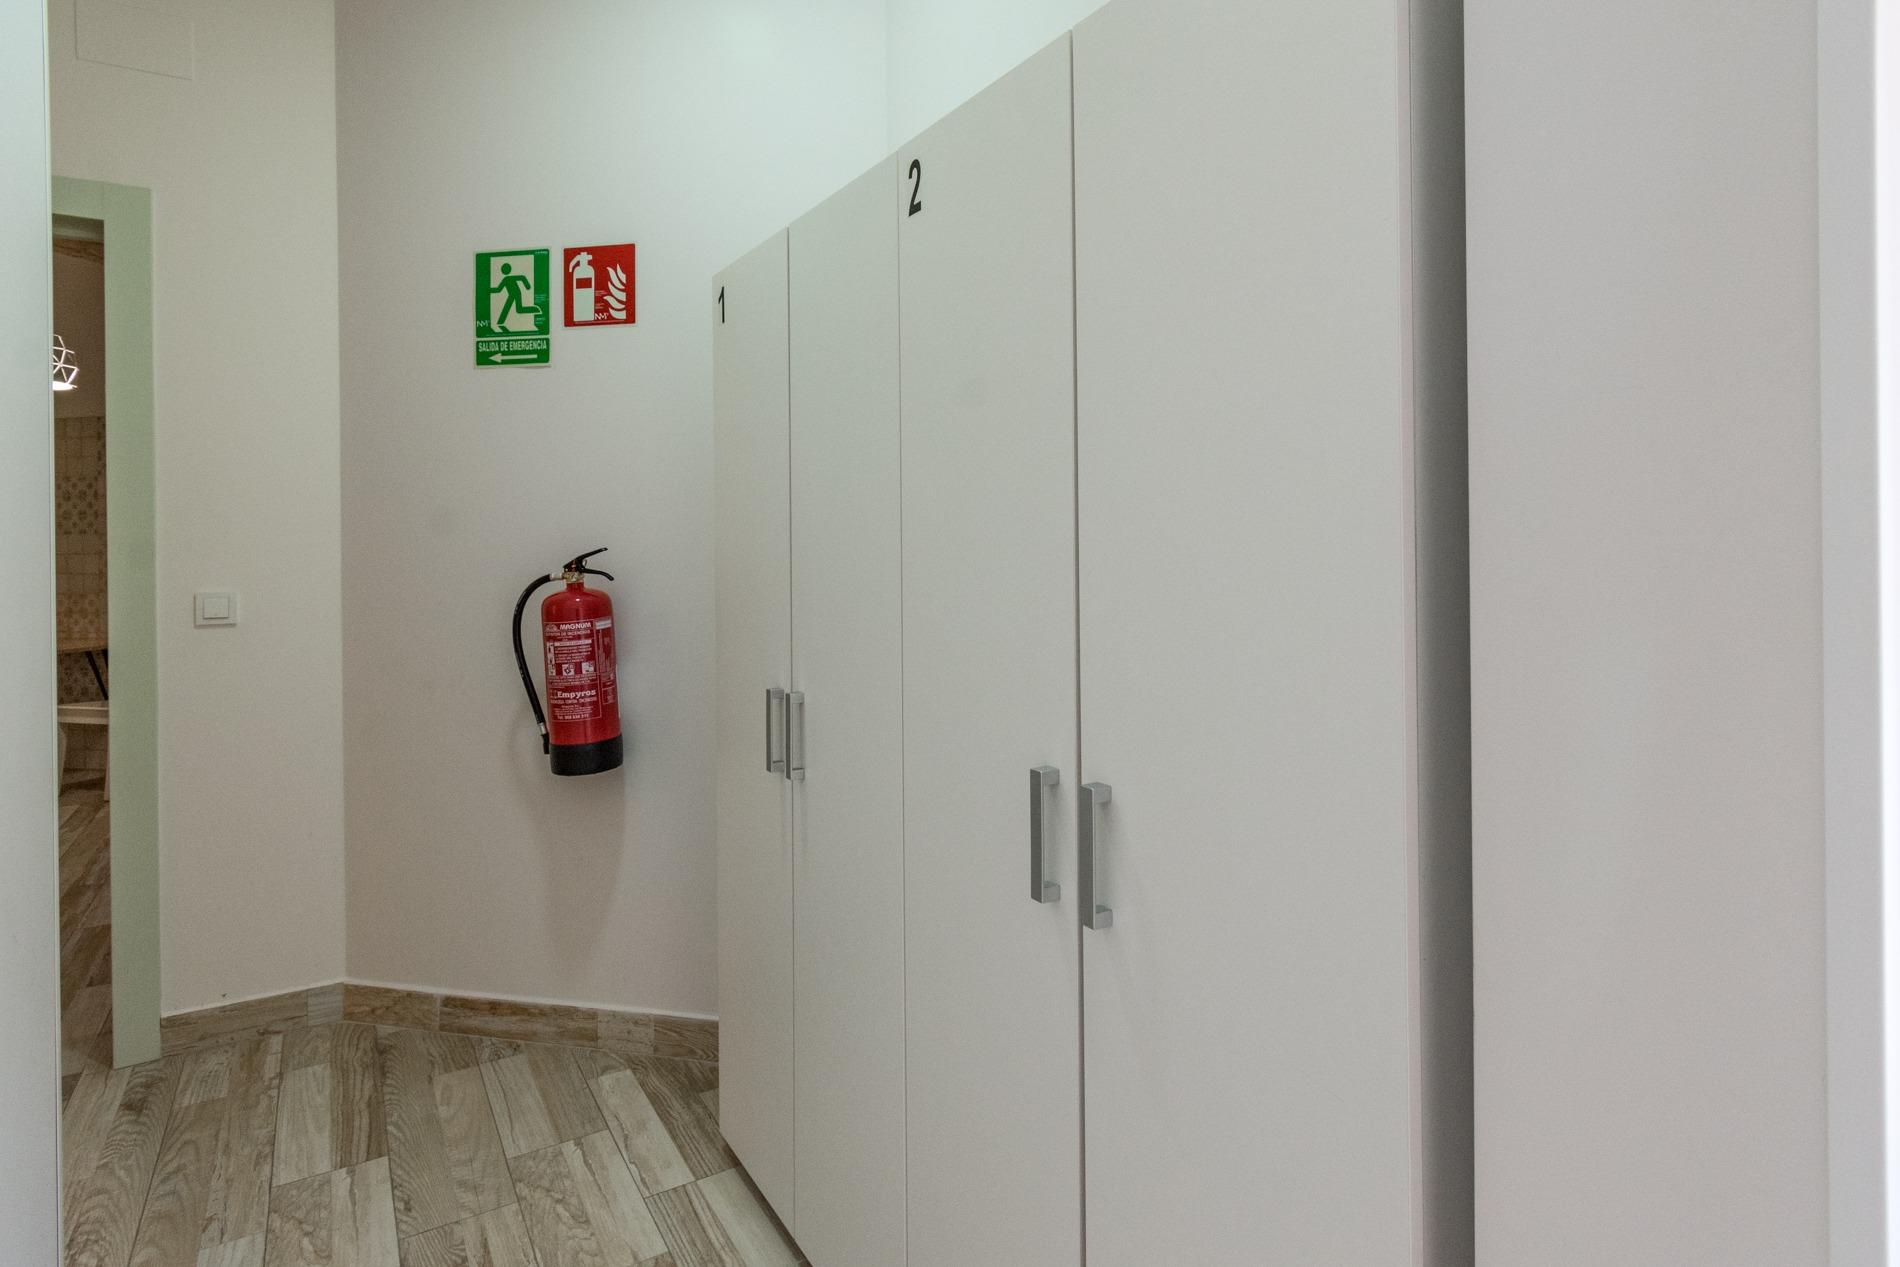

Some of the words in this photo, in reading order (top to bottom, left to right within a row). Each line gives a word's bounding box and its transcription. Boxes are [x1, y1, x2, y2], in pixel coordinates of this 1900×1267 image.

[908, 159, 922, 217] 2
[718, 286, 725, 323] 1
[478, 342, 499, 352] SALIDA
[500, 341, 508, 351] DE
[509, 339, 547, 351] EMERGENCIA
[559, 622, 592, 630] MAGNUM
[557, 690, 596, 699] Empyros
